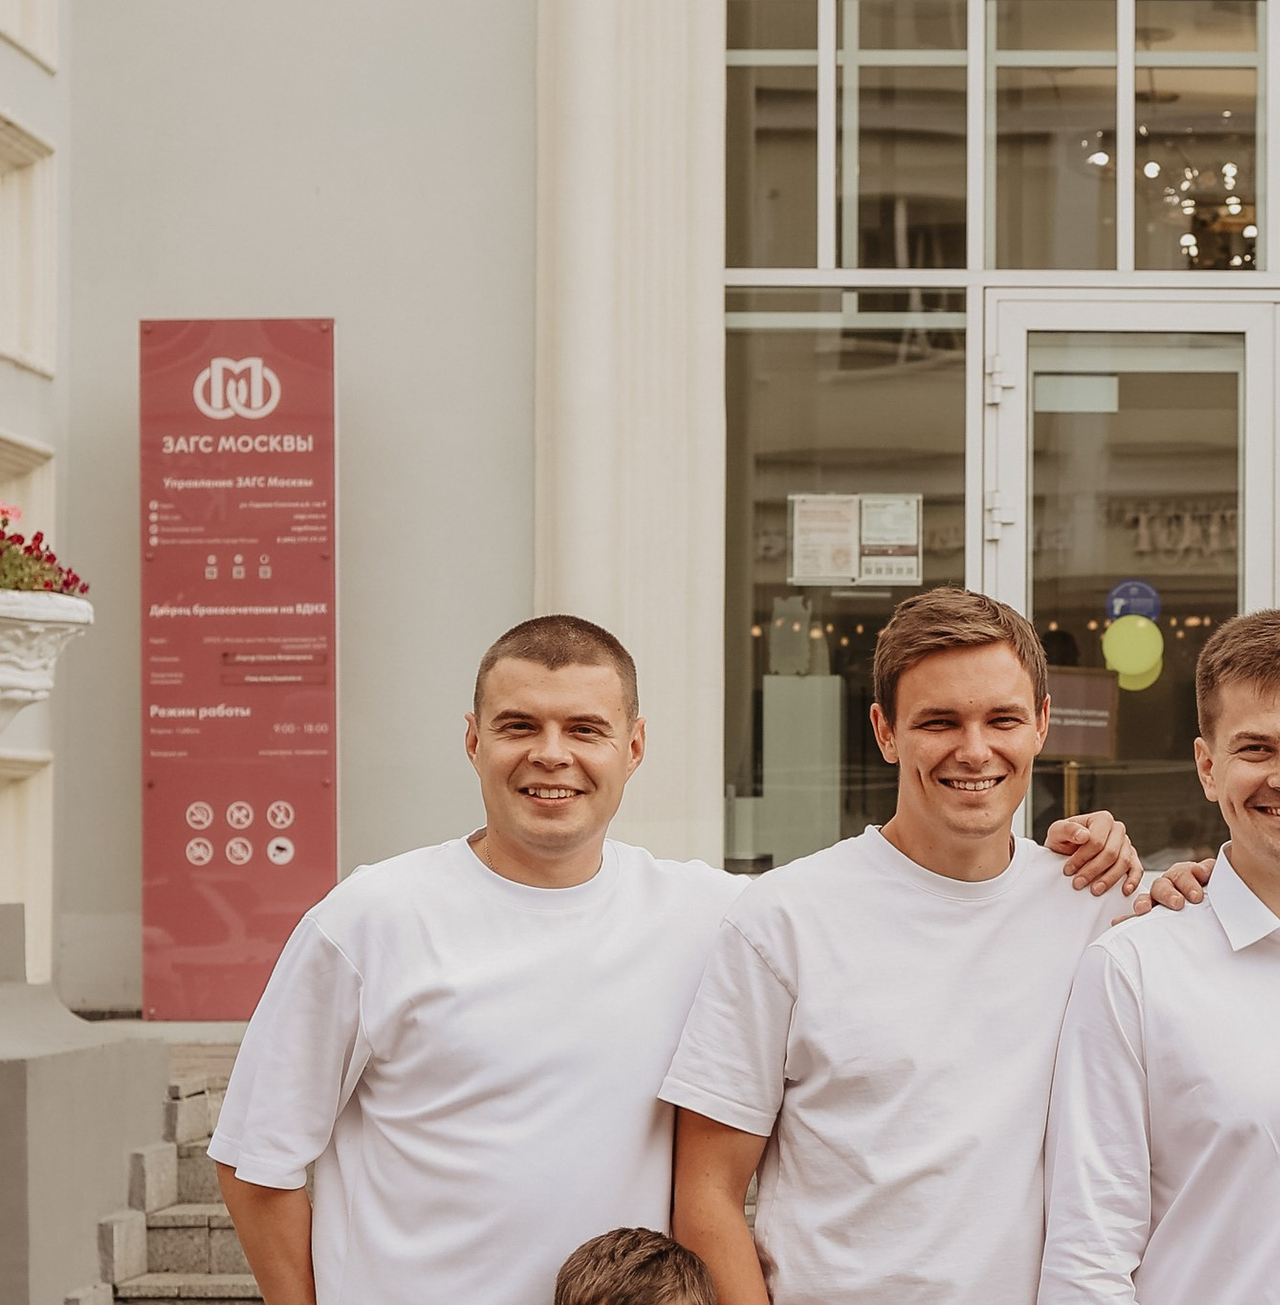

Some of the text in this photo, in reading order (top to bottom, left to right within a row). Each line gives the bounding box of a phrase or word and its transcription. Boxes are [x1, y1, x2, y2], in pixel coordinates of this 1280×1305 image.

[162, 434, 314, 454] ЗАГС МОСКВЫ
[236, 476, 266, 489] ЗАГС
[267, 476, 314, 489] Москвы
[150, 604, 191, 618] Дворец
[280, 605, 294, 615] на
[296, 602, 327, 617] ВДНХ
[150, 702, 251, 720] Режим работы
